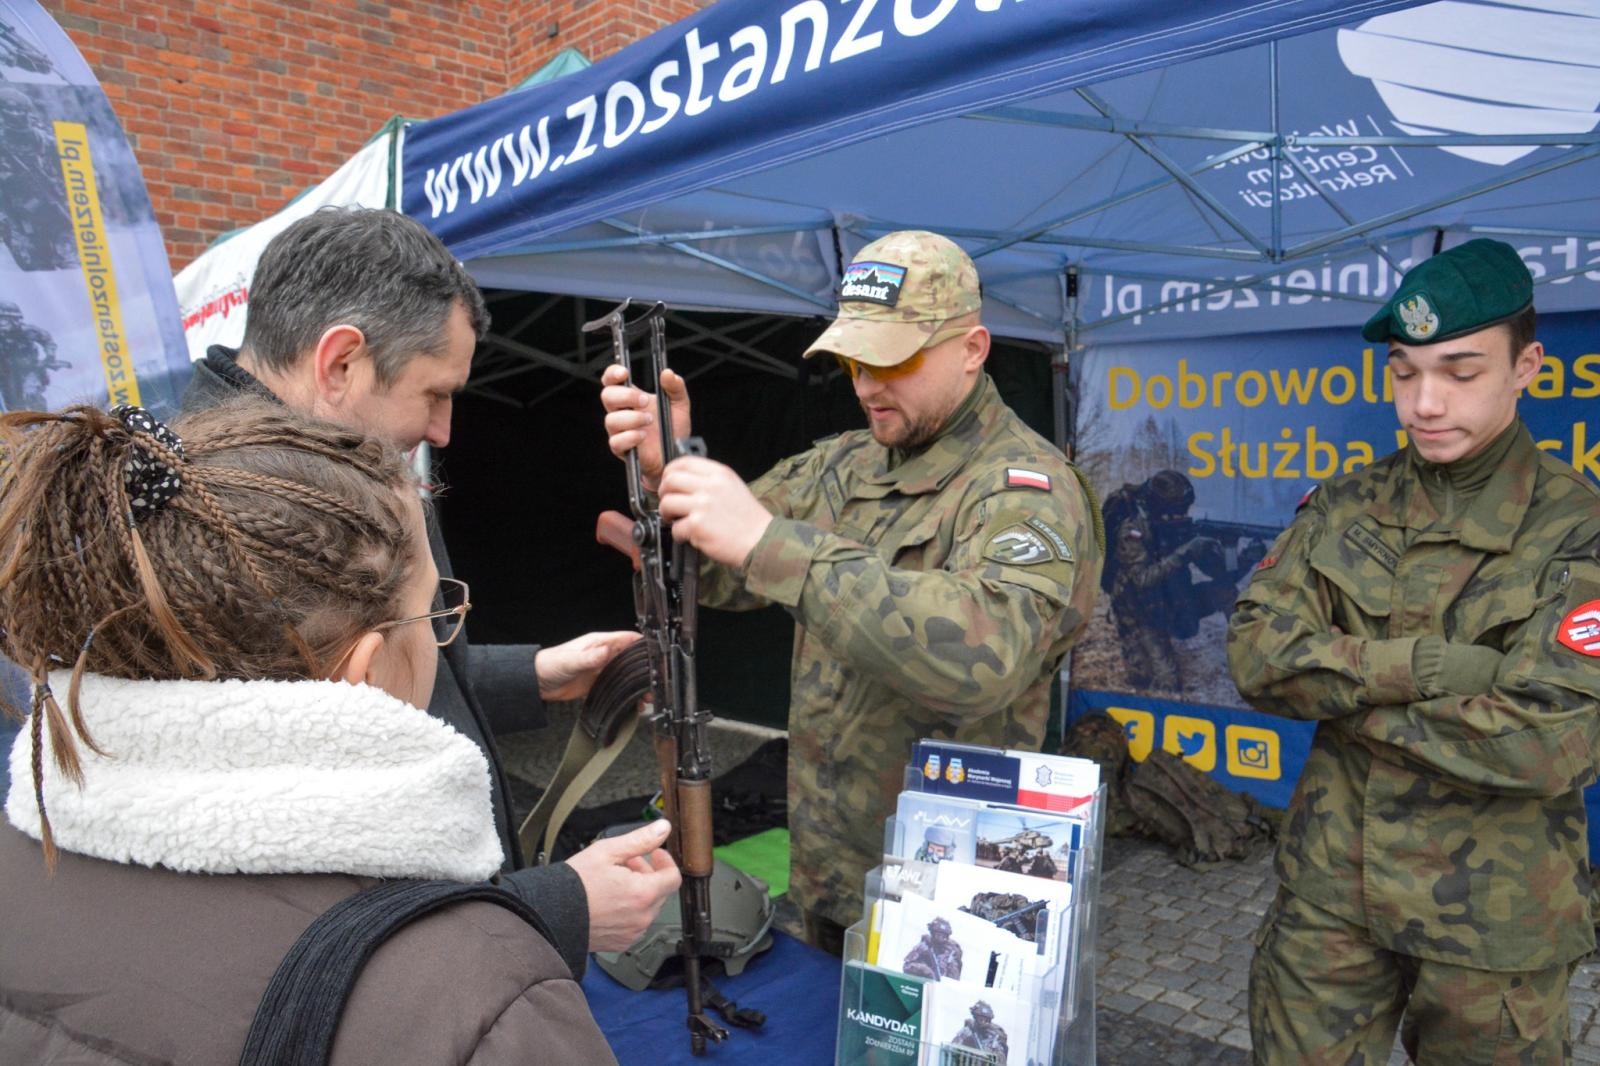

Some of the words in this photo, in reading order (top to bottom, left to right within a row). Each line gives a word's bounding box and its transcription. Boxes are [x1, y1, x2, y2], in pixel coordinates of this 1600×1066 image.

[423, 0, 1003, 218] www.zostanzo
[842, 282, 889, 300] desant
[1516, 354, 1600, 399] as
[1187, 426, 1375, 479] Służba
[847, 1008, 917, 1036] KANDYDAT
